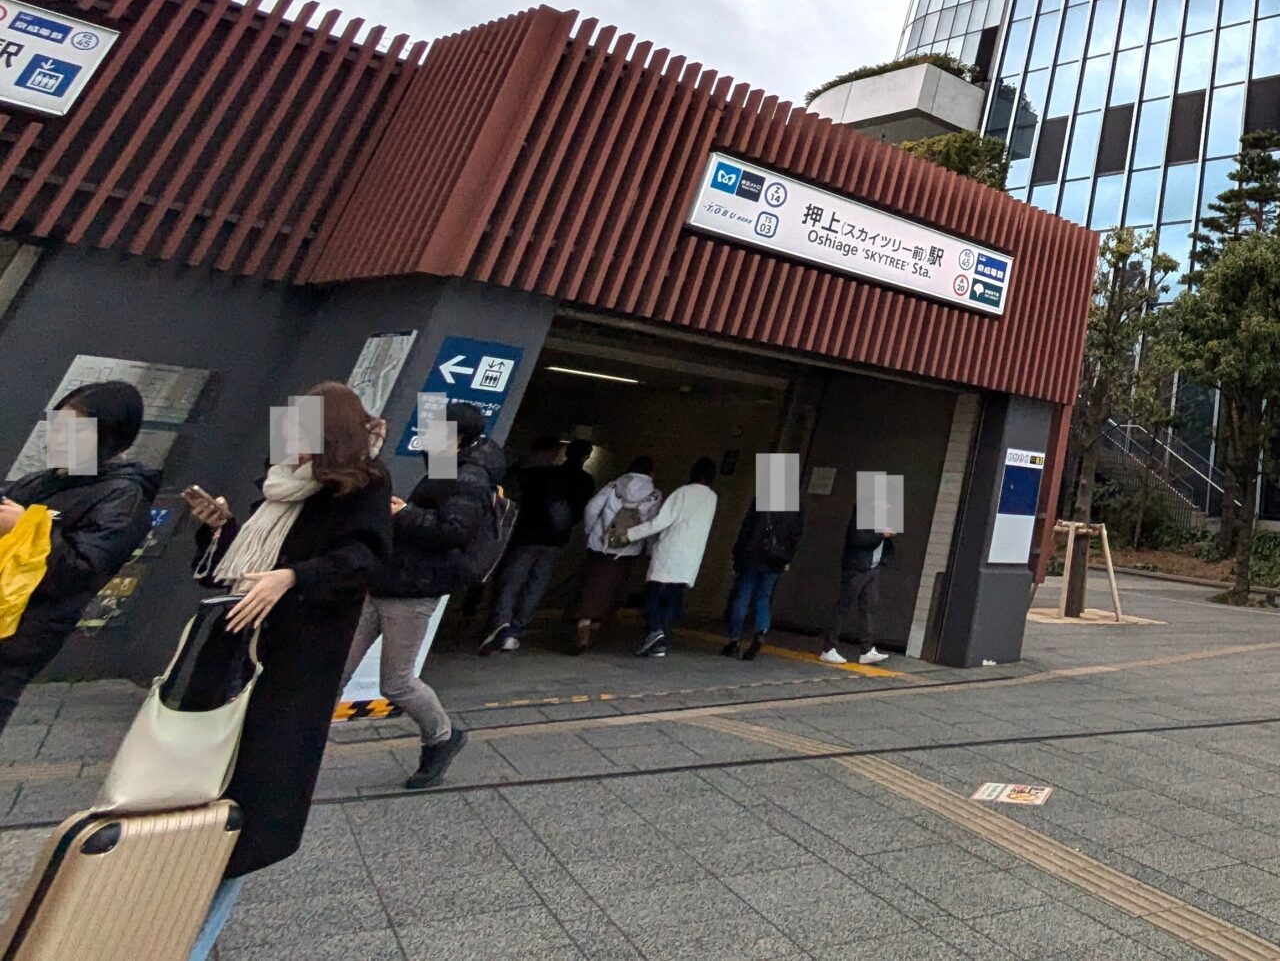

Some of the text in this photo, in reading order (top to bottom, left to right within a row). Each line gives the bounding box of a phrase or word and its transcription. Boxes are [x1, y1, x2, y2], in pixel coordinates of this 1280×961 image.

[76, 39, 92, 49] 45
[770, 193, 782, 204] 14
[759, 223, 772, 234] 03
[807, 229, 859, 256] Oshiage
[911, 262, 932, 279] Sta.
